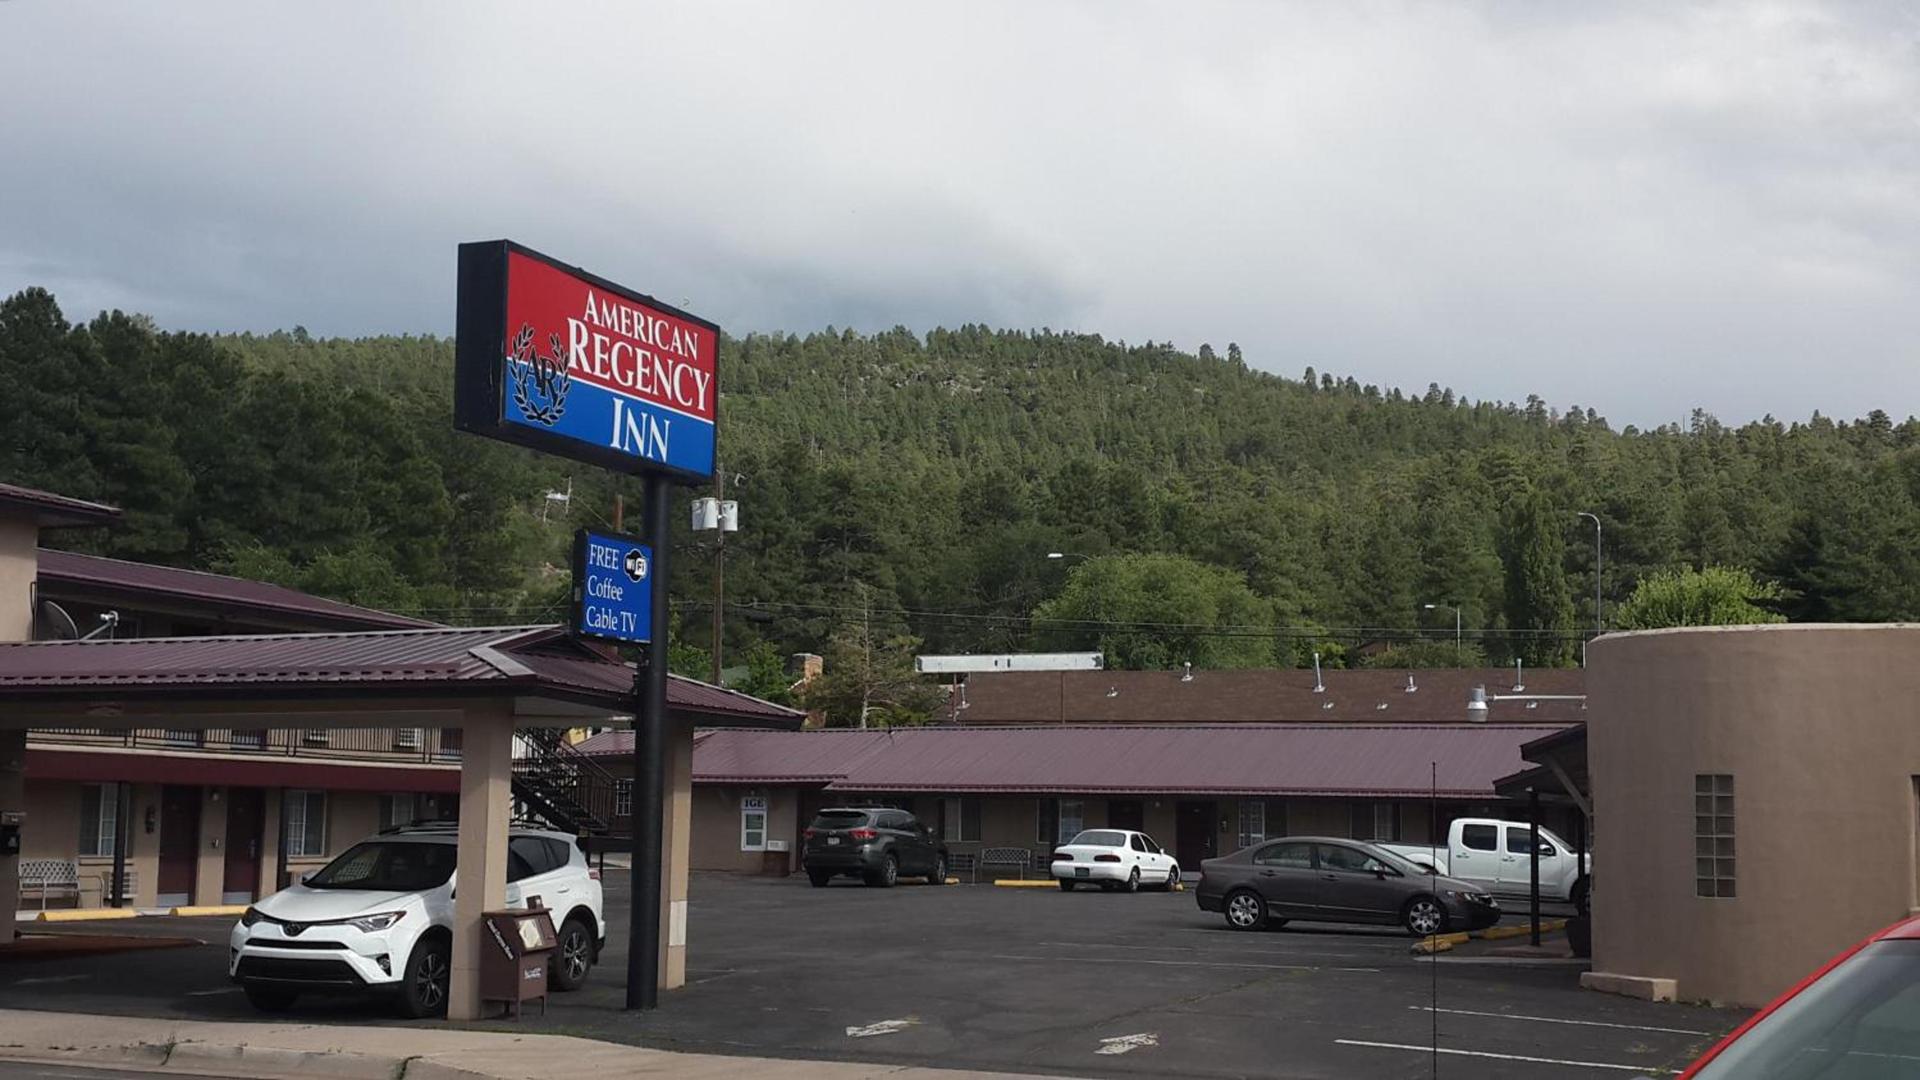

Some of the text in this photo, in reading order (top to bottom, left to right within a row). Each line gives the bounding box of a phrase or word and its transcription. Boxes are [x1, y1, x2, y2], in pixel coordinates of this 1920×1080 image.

[583, 289, 699, 361] AMERICAN
[523, 344, 559, 407] AR
[566, 316, 711, 412] REGENCY
[609, 396, 670, 464] INN
[587, 575, 623, 601] Coffee
[589, 543, 620, 570] FREE
[586, 605, 637, 633] Cable TV
